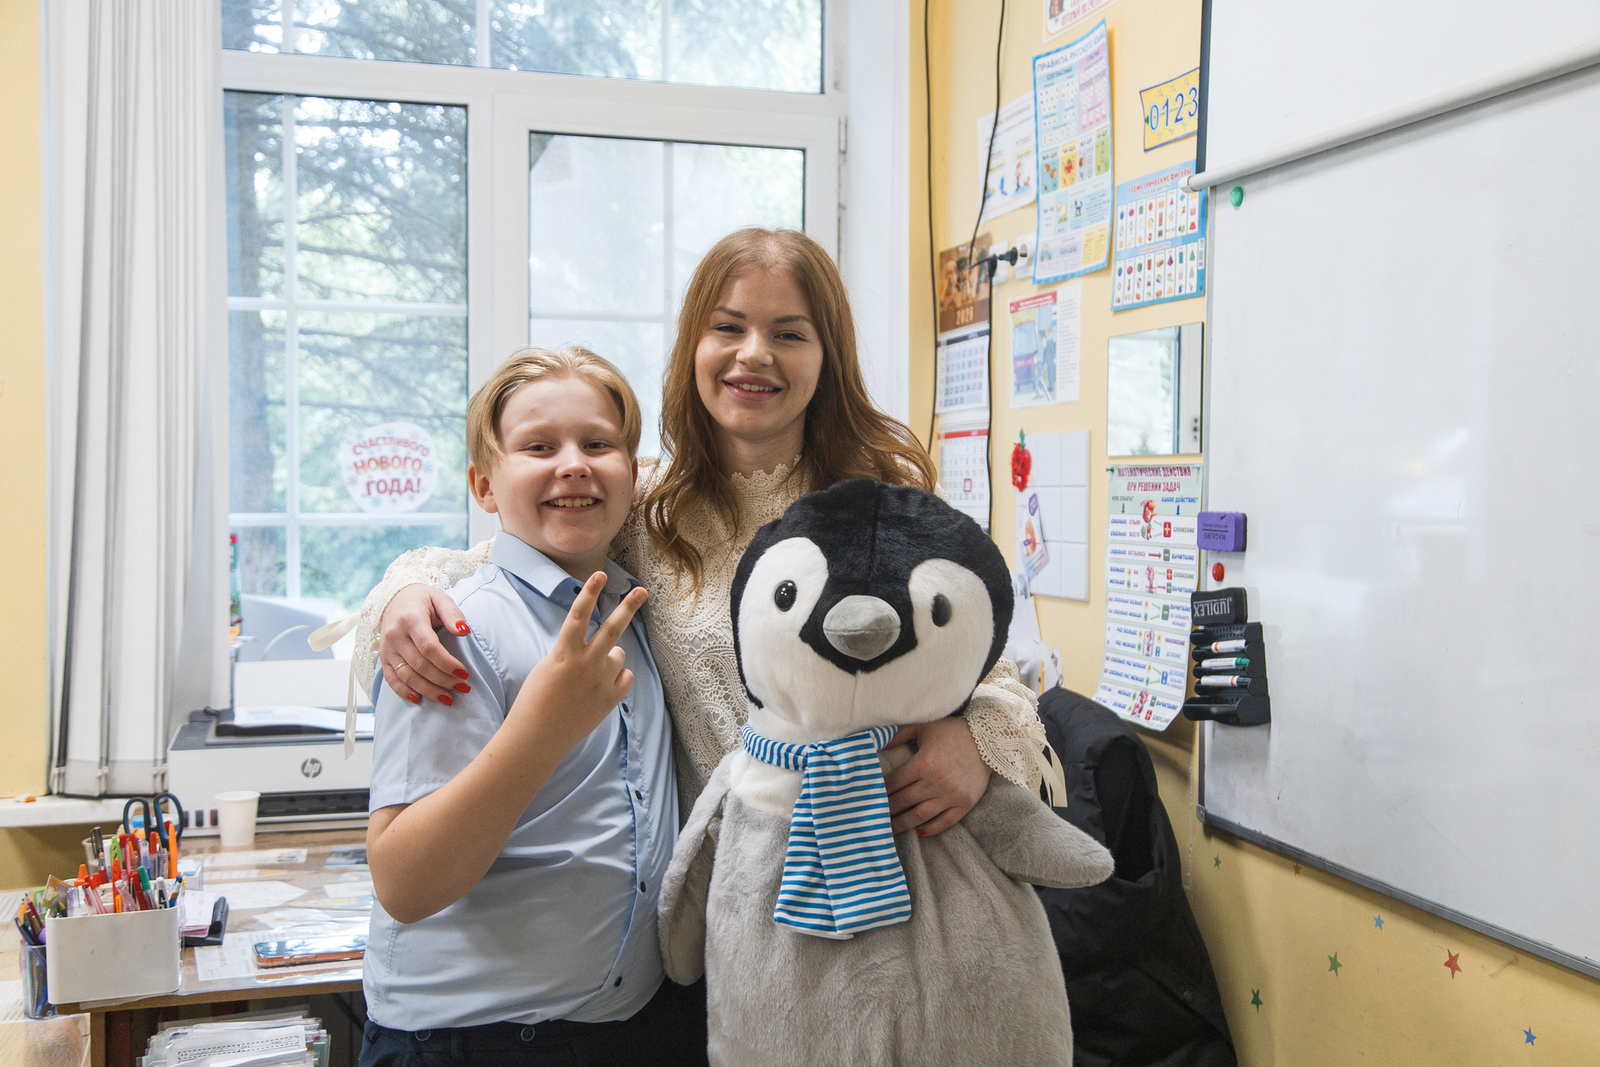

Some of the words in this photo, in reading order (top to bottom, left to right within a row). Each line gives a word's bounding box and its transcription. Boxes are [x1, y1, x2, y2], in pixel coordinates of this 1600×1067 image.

[1128, 174, 1169, 194] ГЕОМЕТРИЧЕСКИЕ
[1170, 168, 1192, 180] ФИГУРЫ
[353, 436, 430, 456] СЧАСТЛИВОГО
[354, 456, 422, 475] НОВОГО
[1118, 467, 1162, 477] МАТЕМАТИЧЕСКИЕ
[1162, 465, 1192, 478] ДЕЙСТВИЯ
[366, 478, 421, 496] ГОДА!
[1127, 482, 1136, 492] ПРИ
[1138, 482, 1162, 492] РЕШЕНИИ
[1162, 482, 1180, 493] ЗАДАЧ
[1193, 597, 1232, 616] JUDILEX
[302, 758, 321, 778] hp
